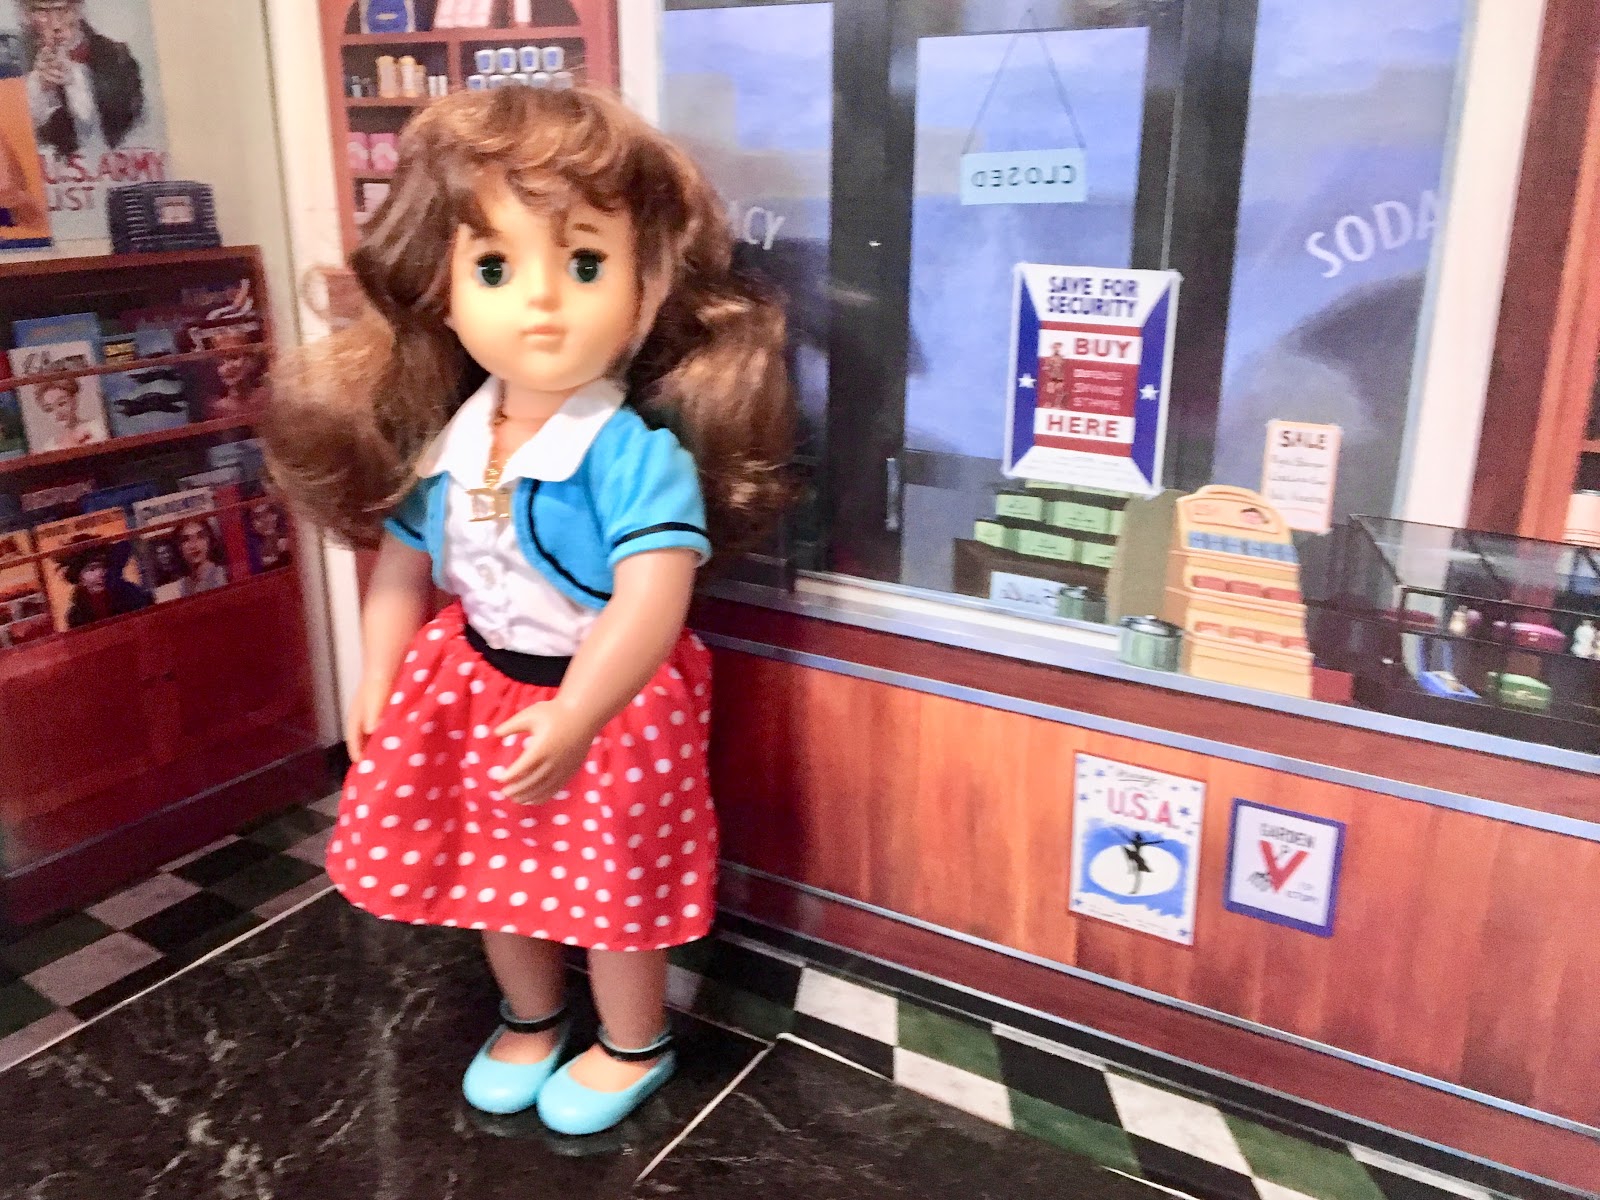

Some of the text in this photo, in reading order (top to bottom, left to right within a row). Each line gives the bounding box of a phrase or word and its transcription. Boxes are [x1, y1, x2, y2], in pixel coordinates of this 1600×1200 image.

[1305, 190, 1437, 279] SODA
[1047, 276, 1138, 298] SAVE FOR
[1046, 295, 1137, 318] SECURITY
[1073, 337, 1132, 358] BUY
[1045, 414, 1121, 438] HERE
[1280, 430, 1328, 451] SALE
